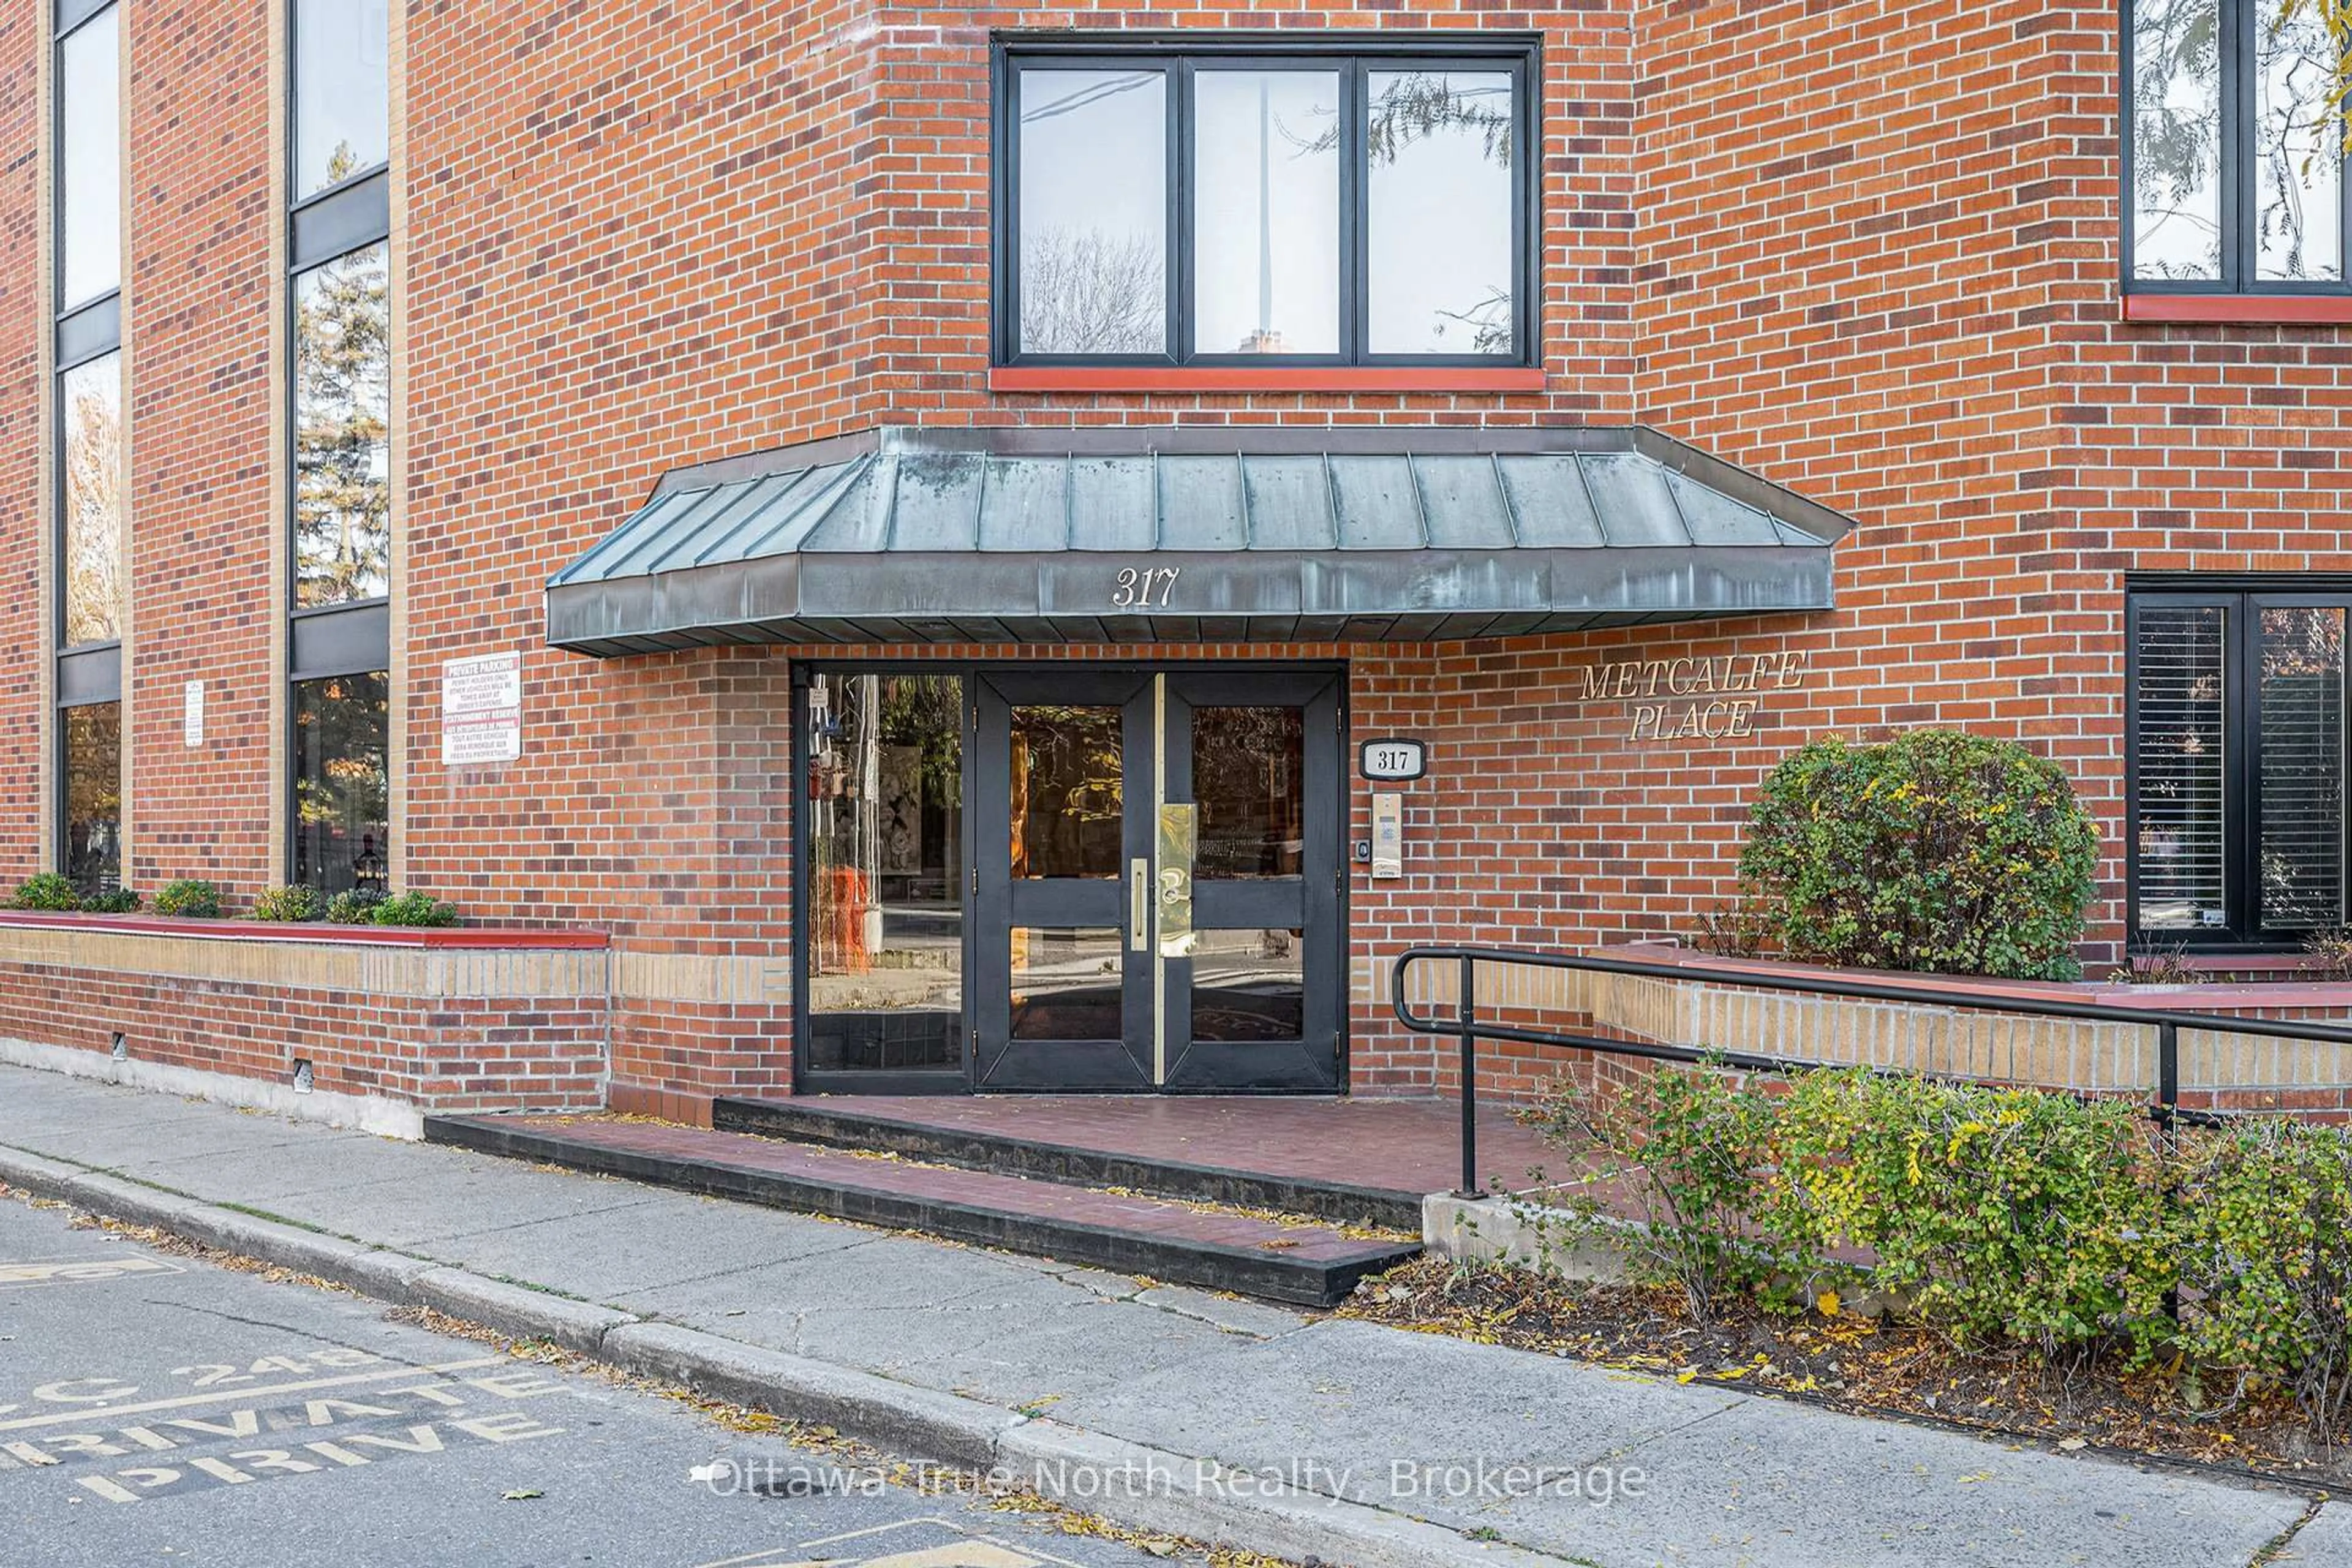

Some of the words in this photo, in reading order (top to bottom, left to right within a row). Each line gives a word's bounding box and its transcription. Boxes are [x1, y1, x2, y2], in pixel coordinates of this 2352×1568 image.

[1112, 567, 1180, 607] 317
[449, 663, 478, 677] PRIVATE
[480, 659, 513, 673] PARKING
[1578, 650, 1806, 701] METCALFE
[1629, 699, 1758, 741] PLACE
[1378, 751, 1408, 770] 317
